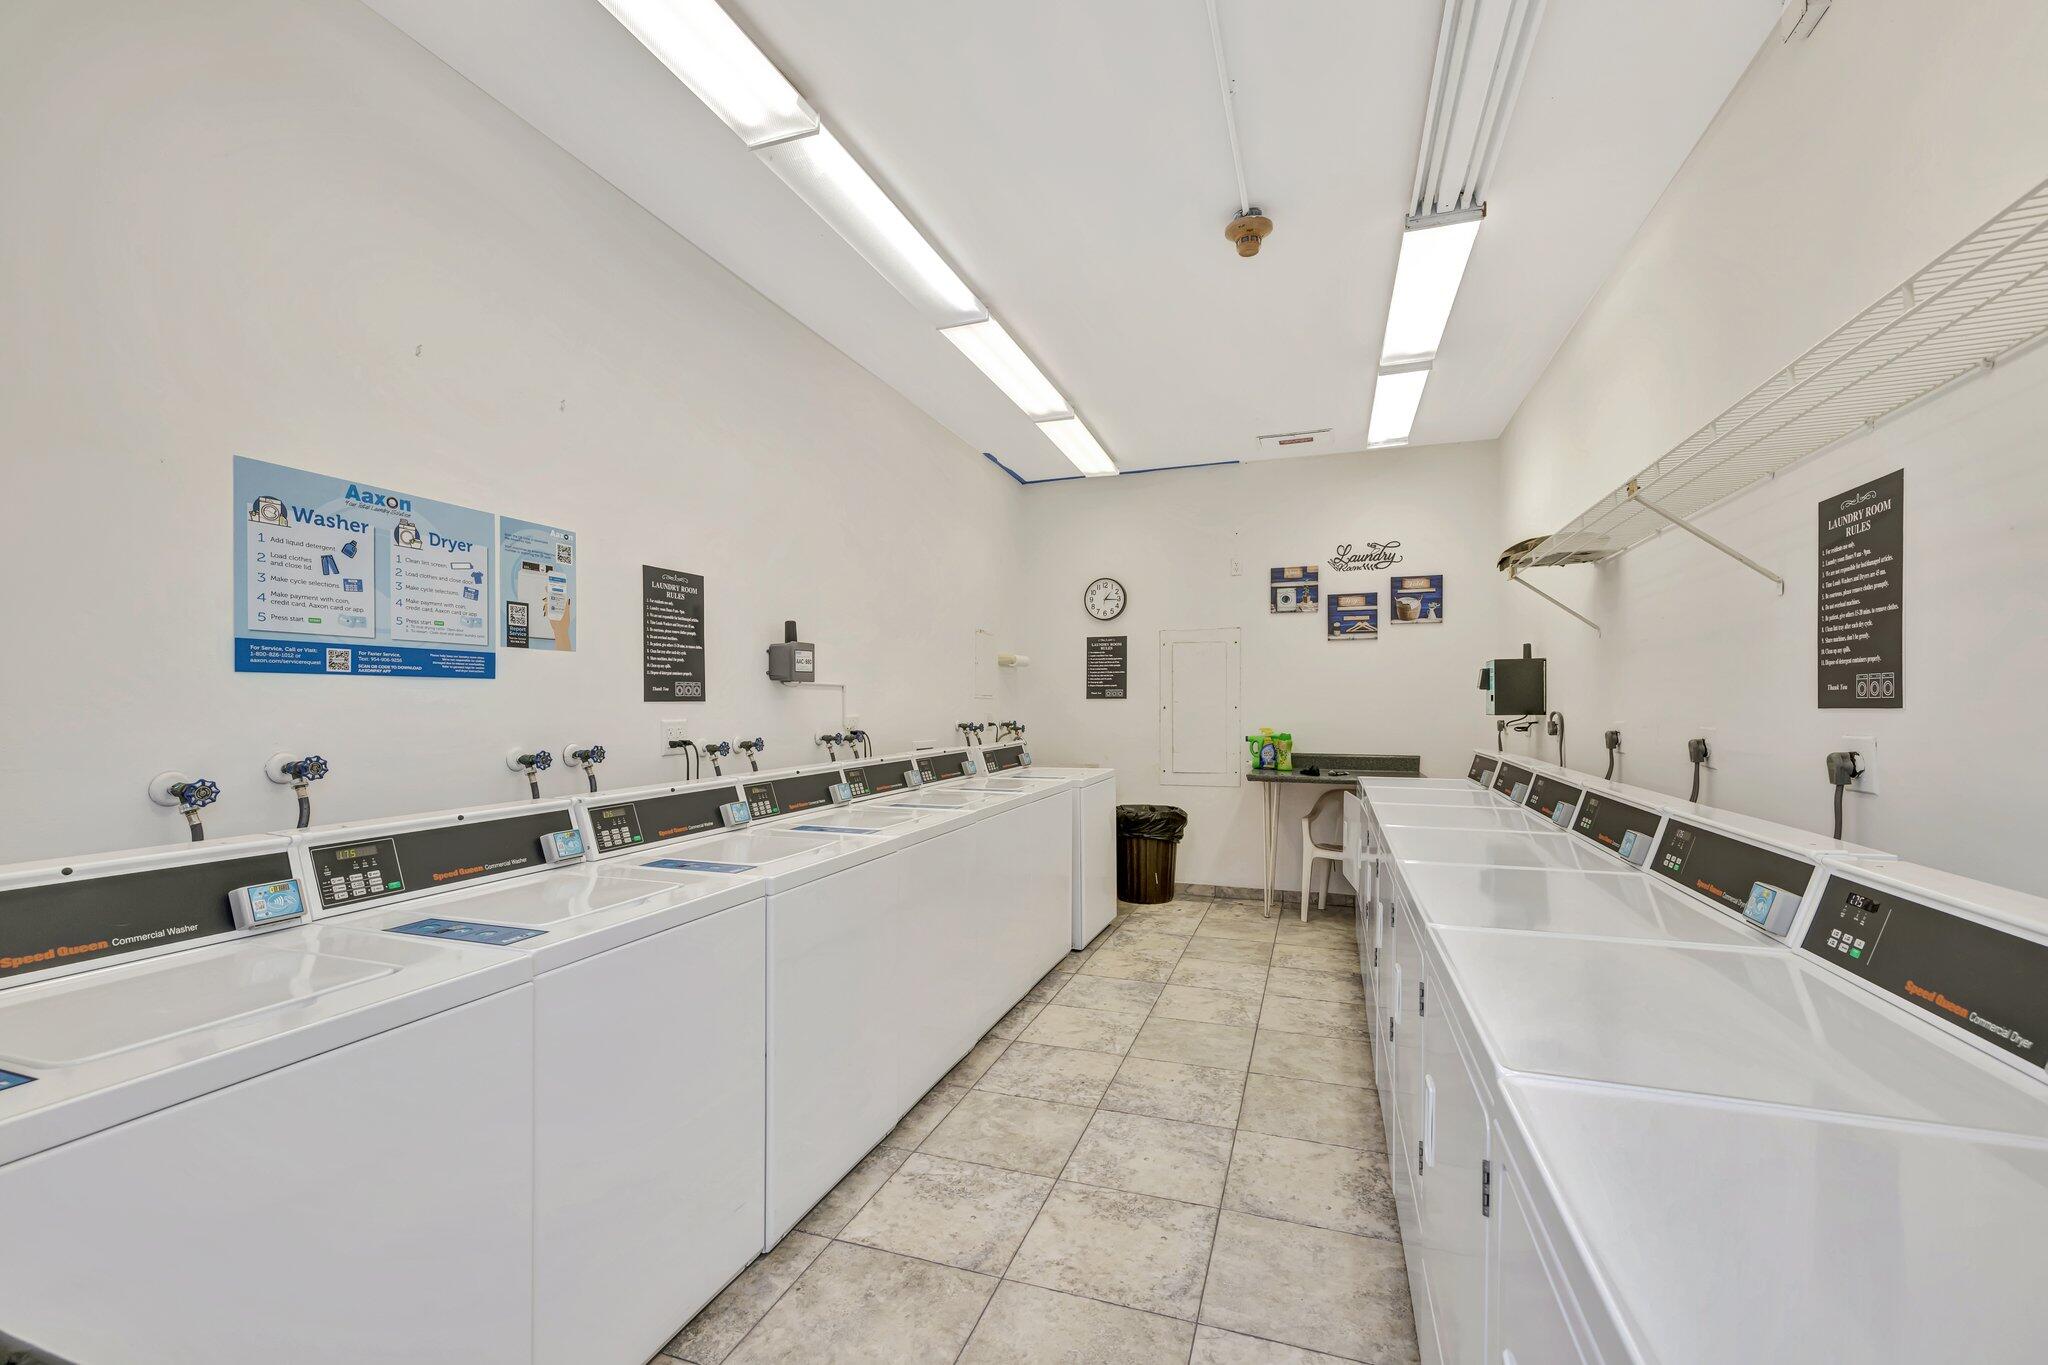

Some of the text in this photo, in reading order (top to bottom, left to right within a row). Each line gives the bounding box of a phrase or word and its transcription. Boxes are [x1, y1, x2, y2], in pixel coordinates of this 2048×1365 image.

[345, 484, 411, 512] Aaxon
[292, 506, 369, 533] Washer
[1828, 499, 1891, 530] LAUNDRY ROOM
[1845, 520, 1871, 537] RULES
[258, 533, 265, 542] 1
[270, 536, 284, 544] Add
[285, 538, 304, 547] liquid
[429, 532, 473, 553] Dryer
[257, 552, 266, 562] 2
[288, 554, 312, 563] clothes
[396, 555, 401, 563] 1
[1334, 541, 1403, 569] Laundry
[257, 572, 265, 582] 3
[270, 575, 288, 583] Make
[290, 578, 307, 586] cycle
[395, 568, 402, 577] 2
[395, 581, 402, 590] 3
[652, 581, 698, 594] LAUNDRY ROOM
[257, 593, 266, 602] 4
[666, 591, 685, 600] RULES
[309, 602, 328, 610] Aaxon
[395, 599, 402, 607] 4
[257, 612, 266, 622] 5
[396, 617, 402, 625] 5
[433, 869, 458, 880] Speed
[459, 865, 484, 875] Queen
[484, 860, 511, 870] Commercial
[0, 923, 198, 968] Speed Queen Commercial Washer
[1904, 980, 2034, 1049] Speed Queen Commercial Dryer
